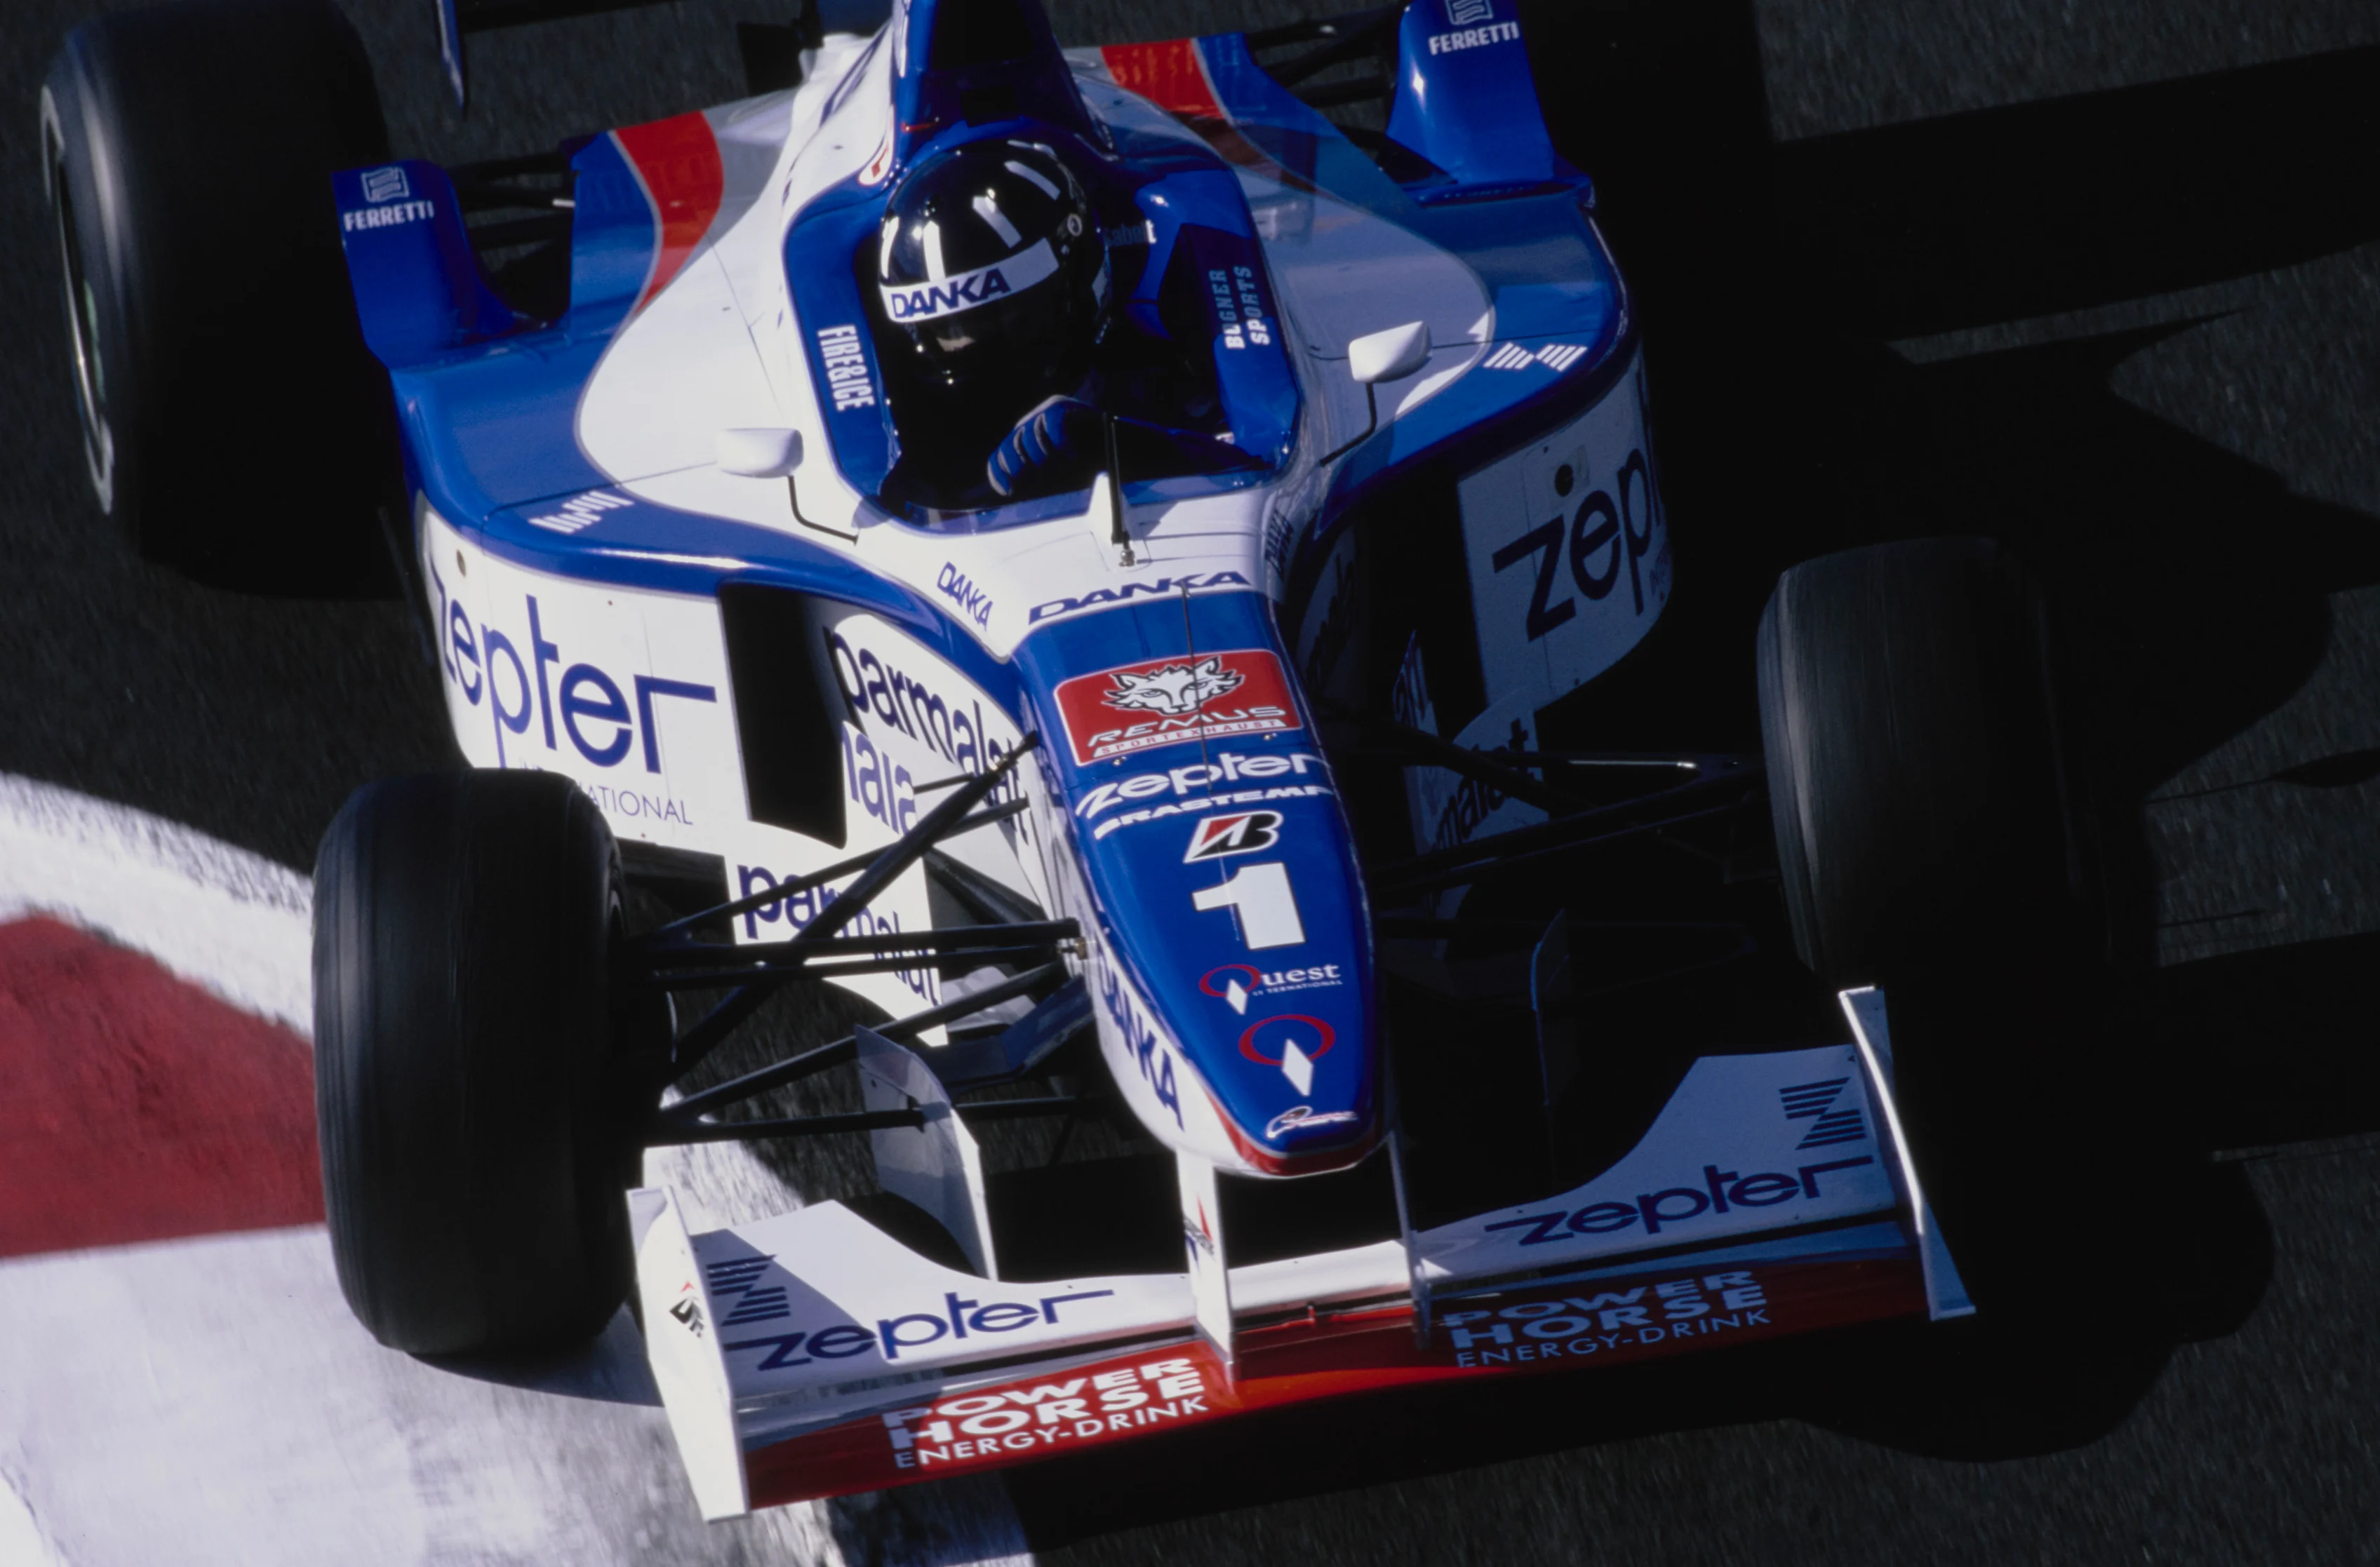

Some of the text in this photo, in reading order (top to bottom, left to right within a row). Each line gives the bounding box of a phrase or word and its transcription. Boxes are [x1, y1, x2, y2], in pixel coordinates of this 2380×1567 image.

[1429, 21, 1520, 55] FERRETTI
[343, 200, 434, 232] FERRETTI
[891, 268, 1010, 319] DANKA
[1234, 265, 1271, 347] SPORTS
[817, 323, 876, 412] FIRE&ICE
[937, 562, 994, 631] DANKA
[1029, 571, 1251, 625] DANKA
[1086, 705, 1288, 748] REMUS
[1100, 720, 1278, 755] SPORTEXHAUST
[1075, 753, 1331, 819] zepter
[1094, 784, 1335, 840] BRASTEMP
[1191, 861, 1306, 950] 1
[1198, 963, 1343, 1016] Quest
[1095, 932, 1185, 1132] DANKA
[1485, 1155, 1874, 1246] zepter
[725, 1290, 1114, 1371] zepter
[1442, 1270, 1753, 1328] POWER
[1447, 1284, 1769, 1349] HORSE
[1457, 1308, 1772, 1368] ENERGY-DRINK
[882, 1358, 1194, 1429] POWER
[887, 1376, 1203, 1450] HORSE
[895, 1397, 1209, 1470] ENERGY-DRINK
